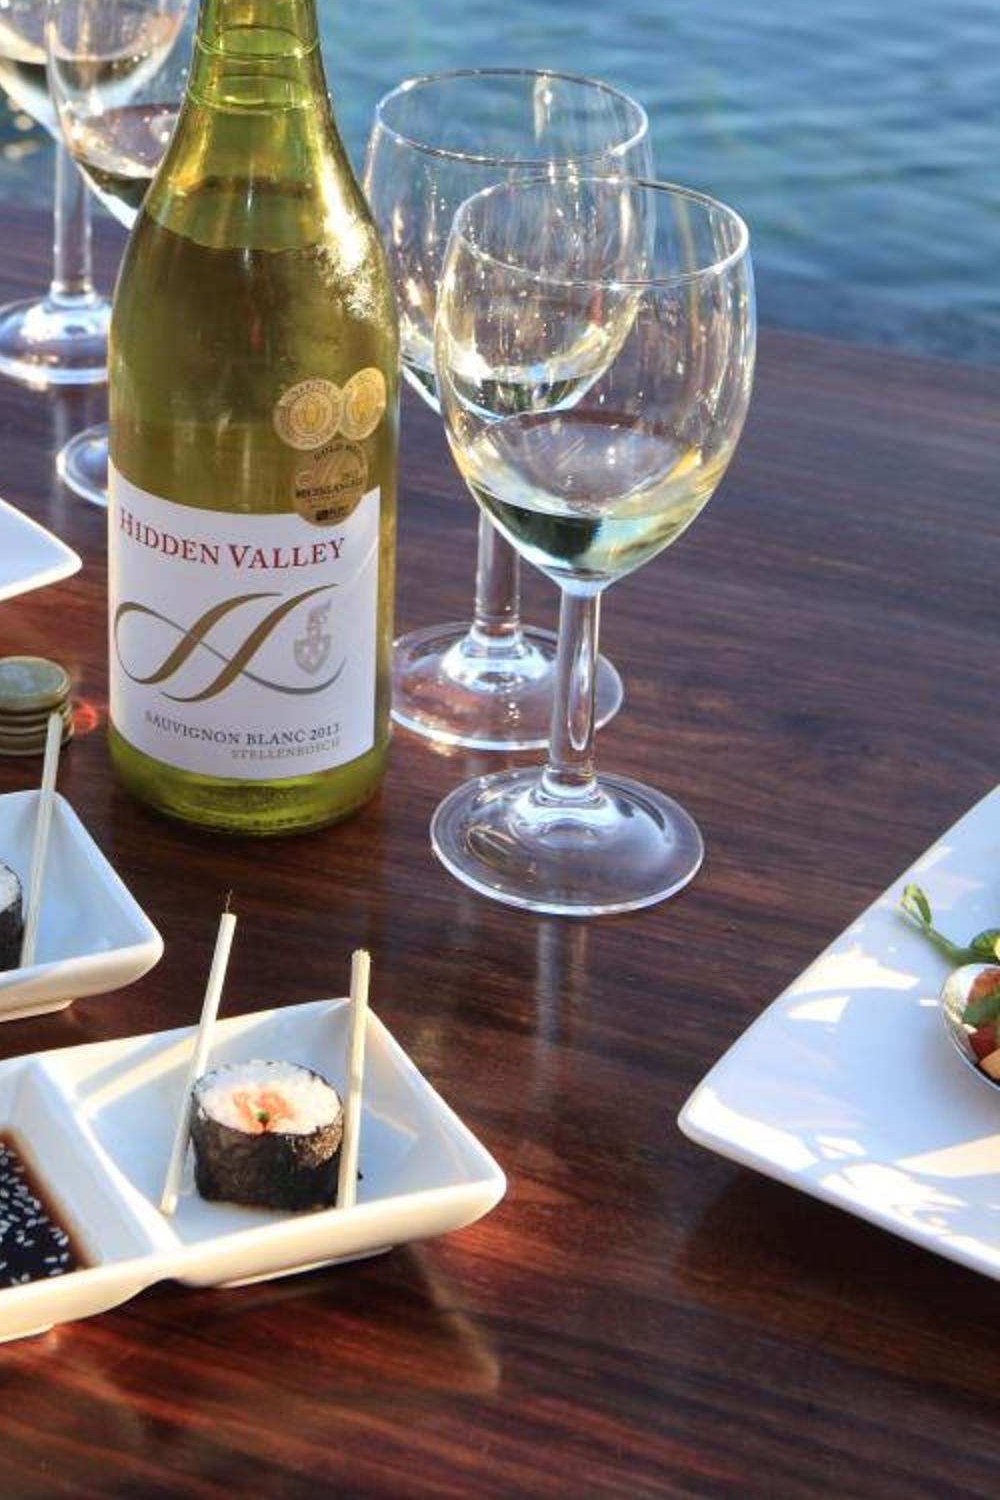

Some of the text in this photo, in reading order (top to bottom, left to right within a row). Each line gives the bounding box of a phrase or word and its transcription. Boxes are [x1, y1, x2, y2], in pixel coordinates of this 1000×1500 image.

[119, 506, 345, 569] HIDDEN VALLEY
[145, 710, 241, 745] SAUVIGNON
[247, 729, 306, 746] BLANC
